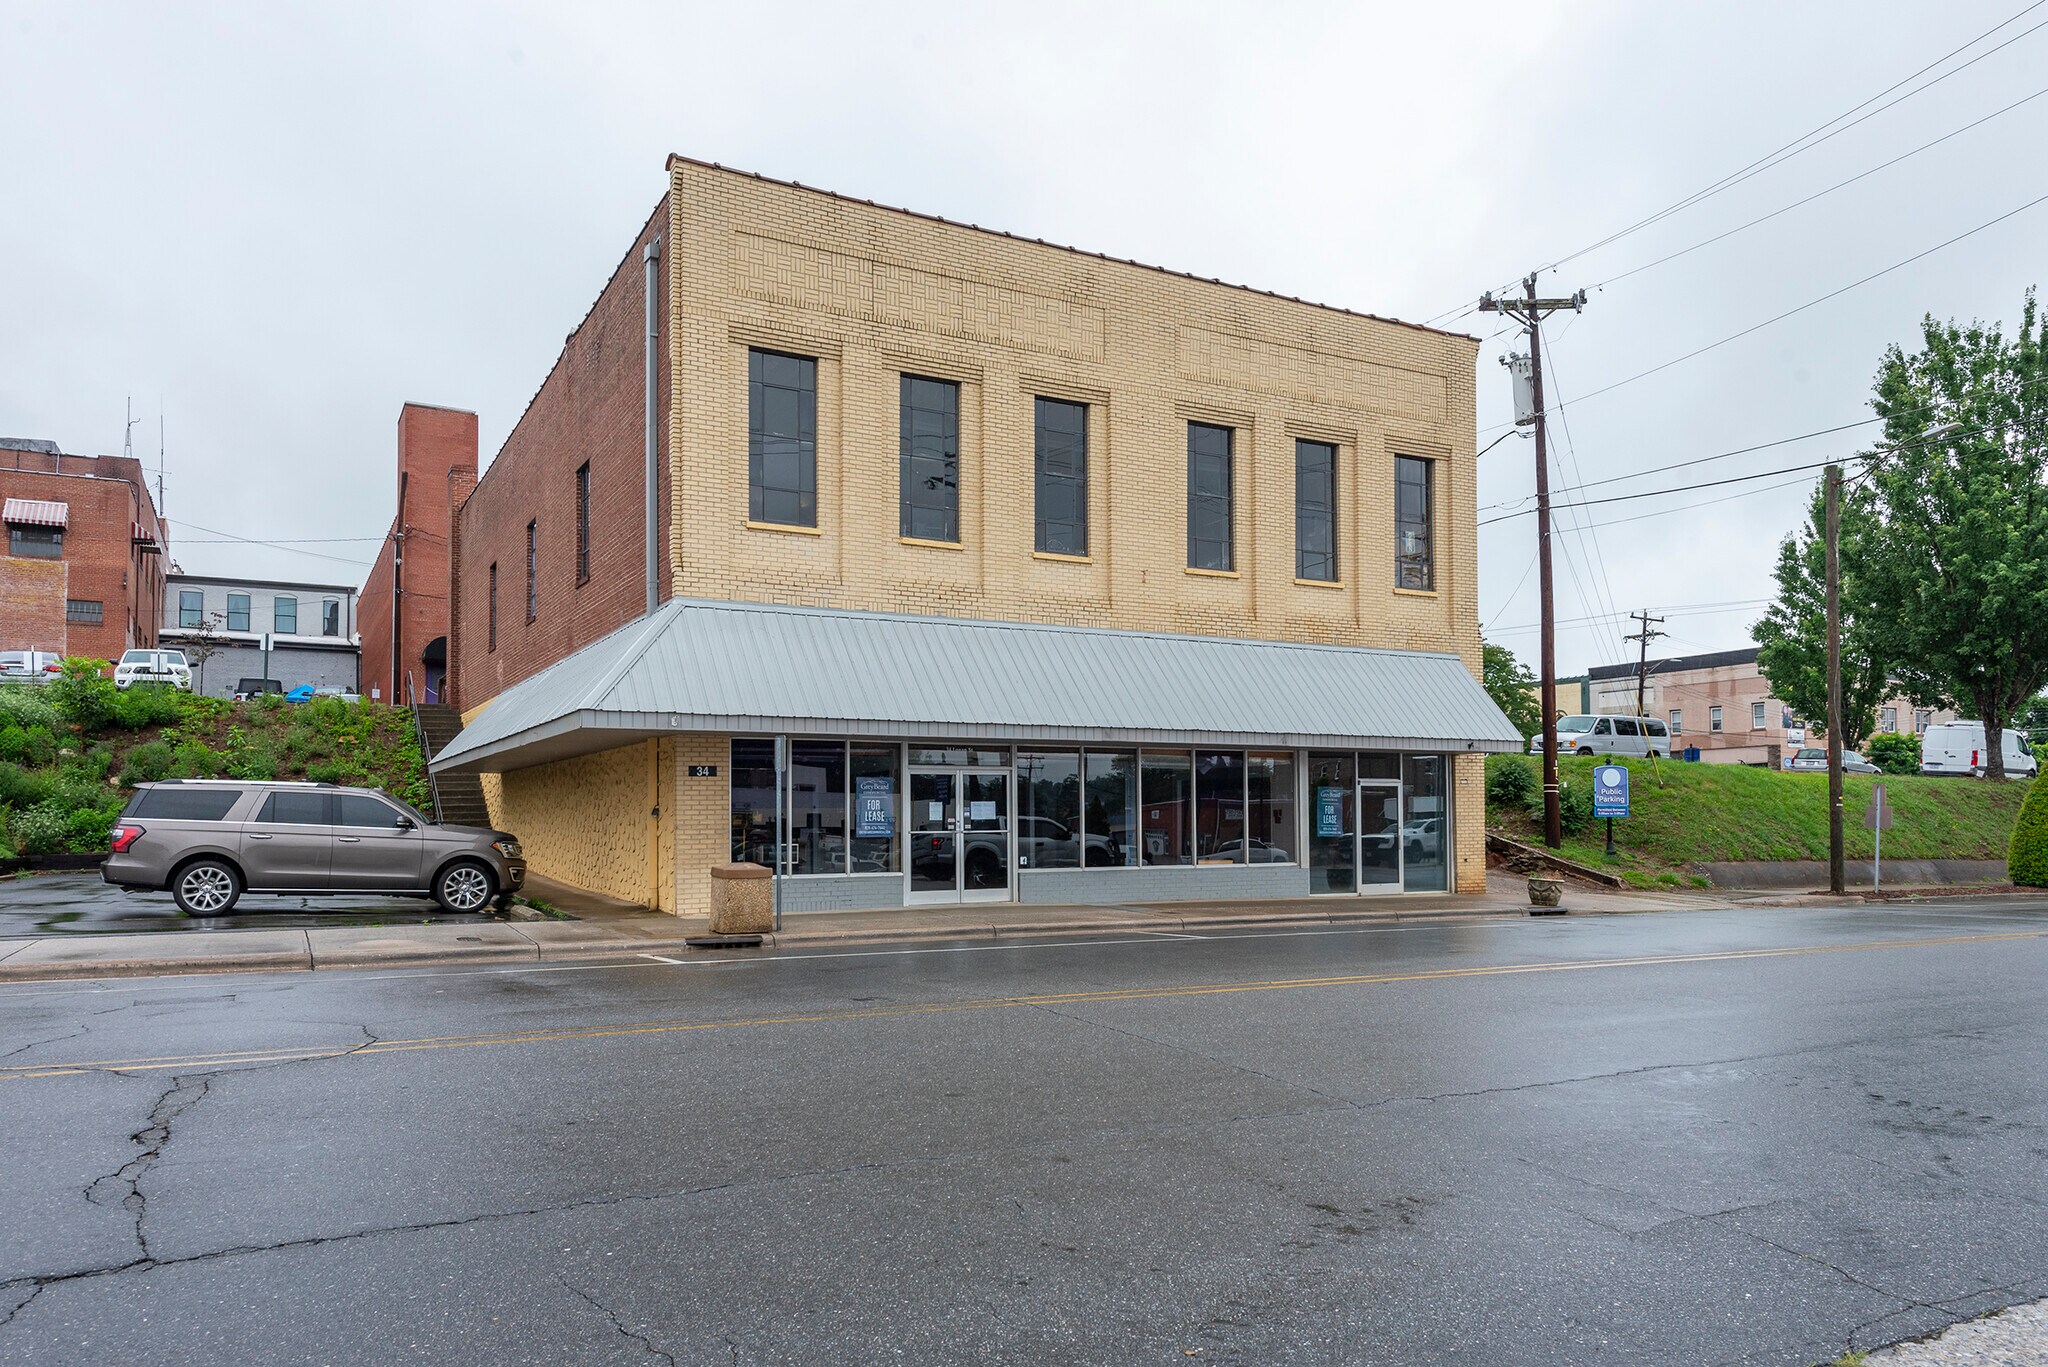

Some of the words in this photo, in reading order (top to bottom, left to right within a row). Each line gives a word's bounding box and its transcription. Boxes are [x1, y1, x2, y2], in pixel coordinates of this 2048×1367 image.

[696, 766, 709, 776] 34
[1598, 795, 1625, 803] Parking
[867, 799, 881, 810] FOR
[1324, 805, 1335, 815] FOR
[864, 811, 885, 822] LEASE
[1323, 815, 1337, 824] LEASE
